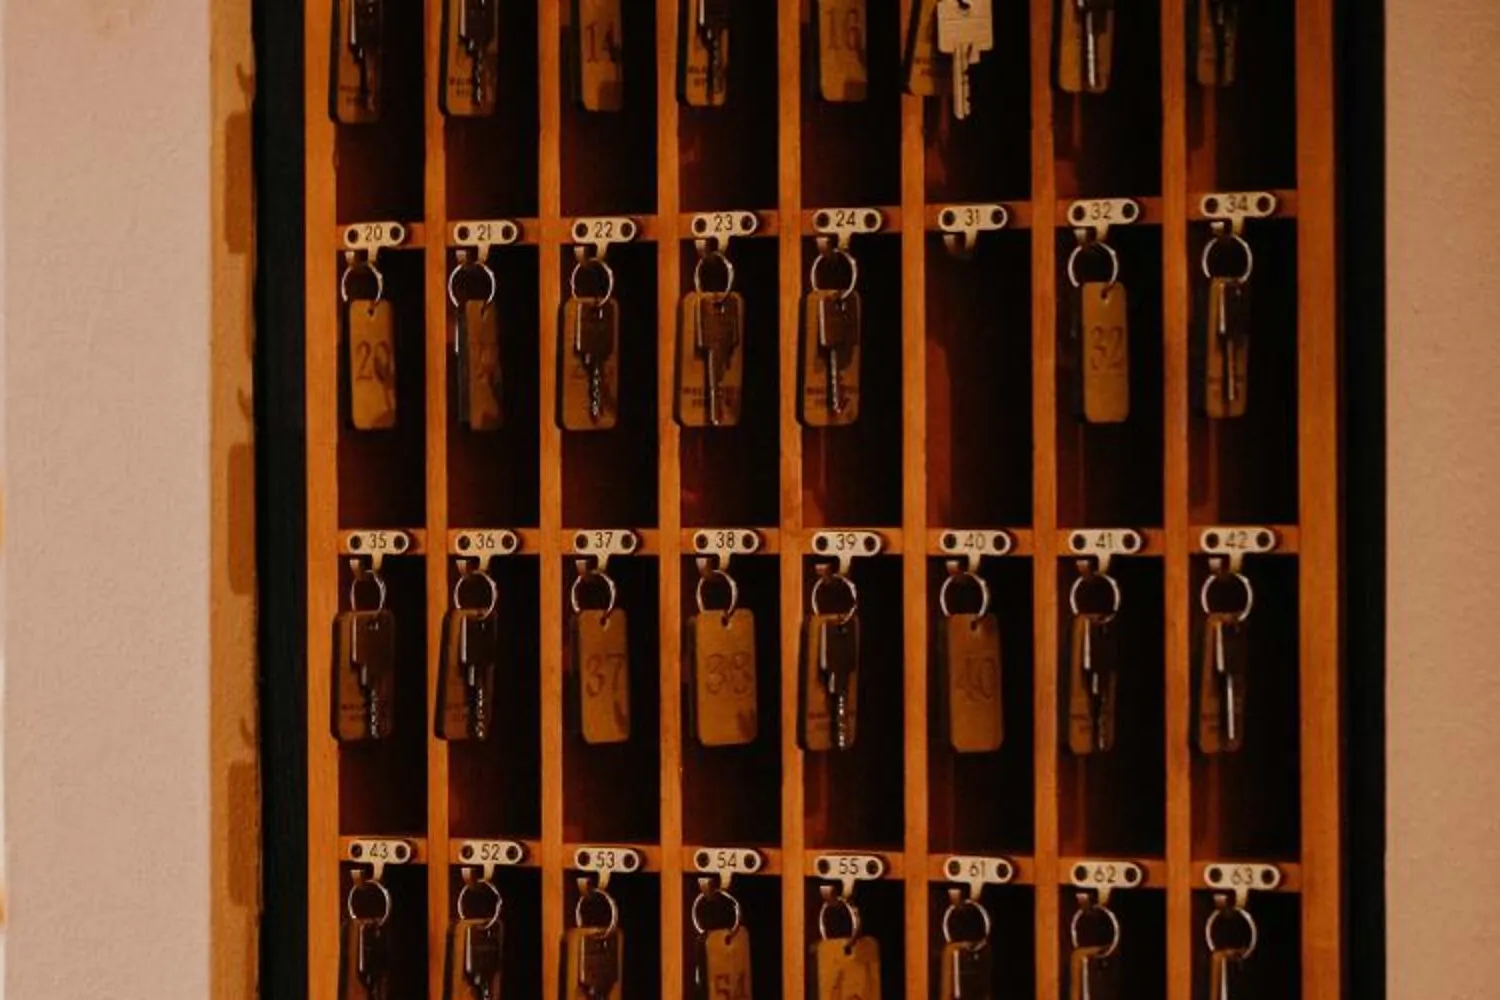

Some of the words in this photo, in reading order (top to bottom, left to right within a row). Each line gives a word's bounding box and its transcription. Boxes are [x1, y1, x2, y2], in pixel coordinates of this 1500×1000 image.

[825, 8, 859, 52] 16
[1091, 202, 1112, 220] 32
[1226, 195, 1249, 213] 34
[714, 215, 733, 232] 23
[835, 210, 856, 227] 24
[964, 208, 980, 226] 31
[364, 224, 383, 241] 20
[476, 224, 493, 240] 21
[594, 222, 613, 238] 22
[355, 340, 391, 382] 20
[368, 533, 387, 549] 35
[476, 533, 495, 549] 36
[594, 532, 613, 548] 37
[716, 532, 735, 548] 38
[835, 534, 856, 551] 39
[964, 533, 986, 550] 40
[1095, 533, 1114, 549] 41
[1225, 532, 1248, 549] 42
[586, 653, 625, 697] 37
[706, 653, 751, 695] 38
[369, 843, 388, 859] 43
[480, 844, 500, 861] 52
[596, 852, 615, 869] 53
[716, 852, 737, 869] 54
[839, 858, 859, 875] 55
[969, 861, 986, 877] 61
[1094, 865, 1117, 883] 62
[1231, 867, 1253, 885] 63
